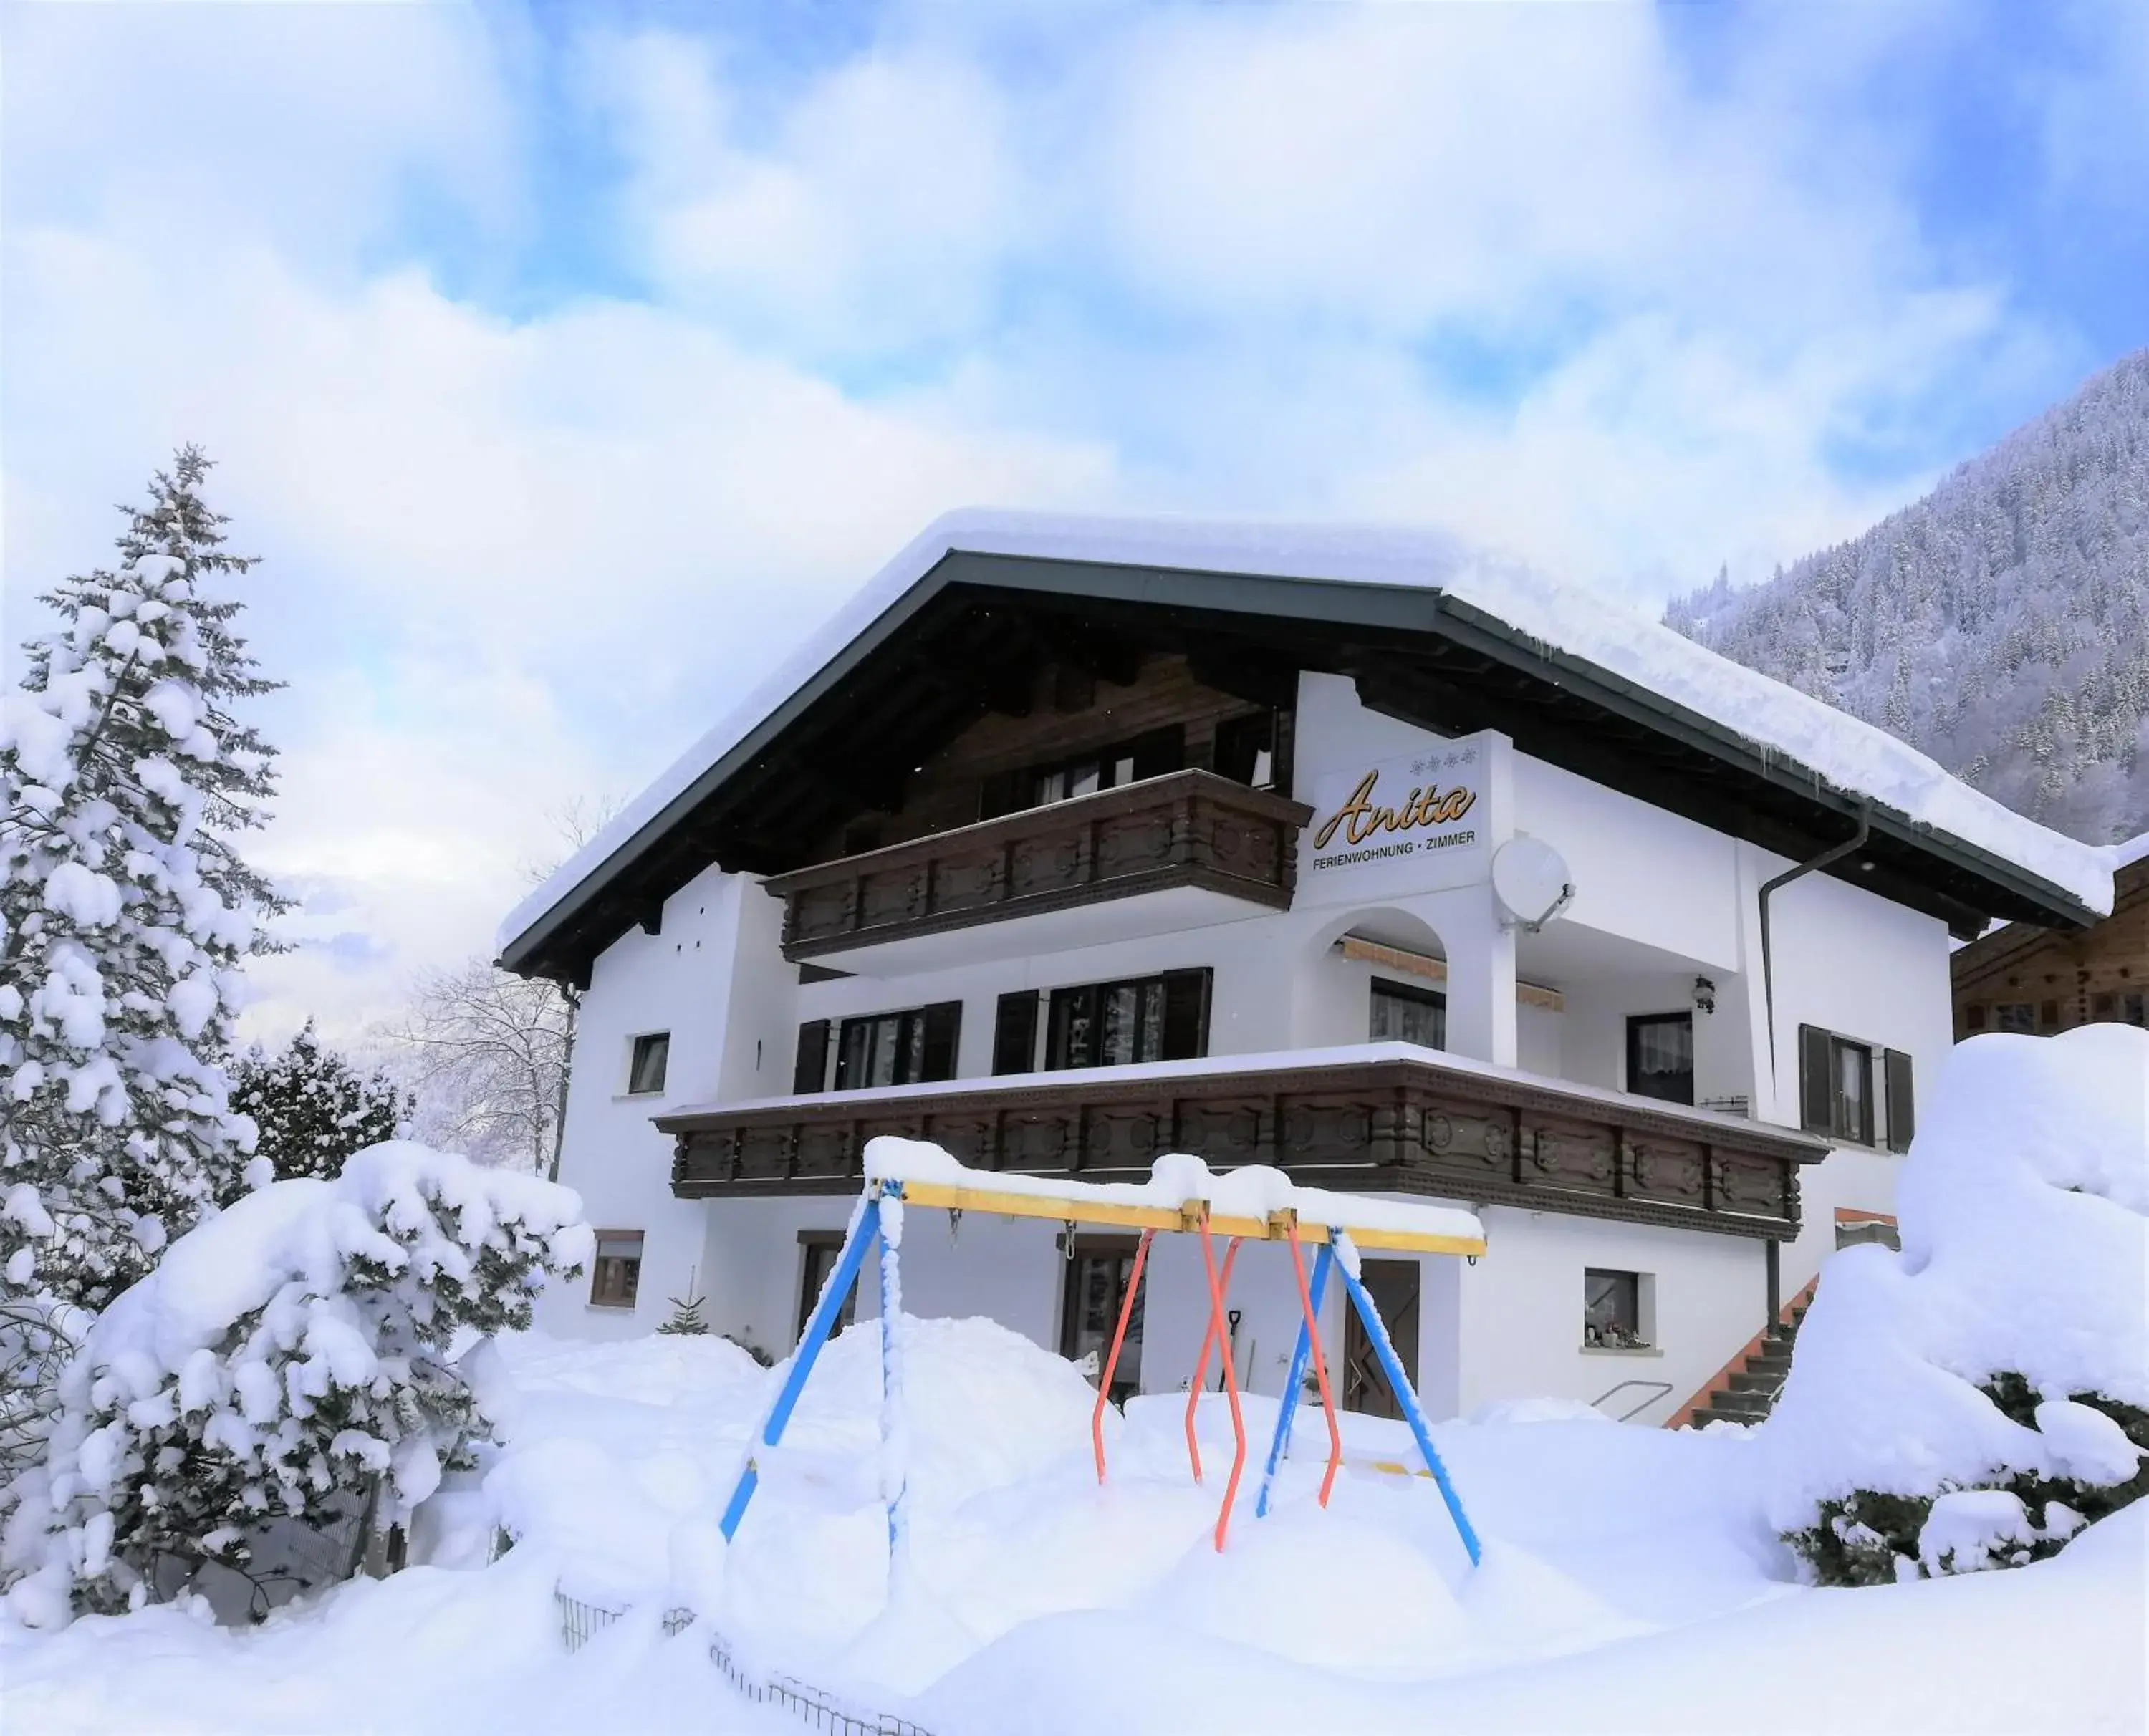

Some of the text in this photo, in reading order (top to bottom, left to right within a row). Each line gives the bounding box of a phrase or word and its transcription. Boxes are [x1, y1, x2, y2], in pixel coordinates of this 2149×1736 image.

[1314, 768, 1476, 849] Anita
[1313, 831, 1475, 871] FERIENWOHNUNG ZIMMER
